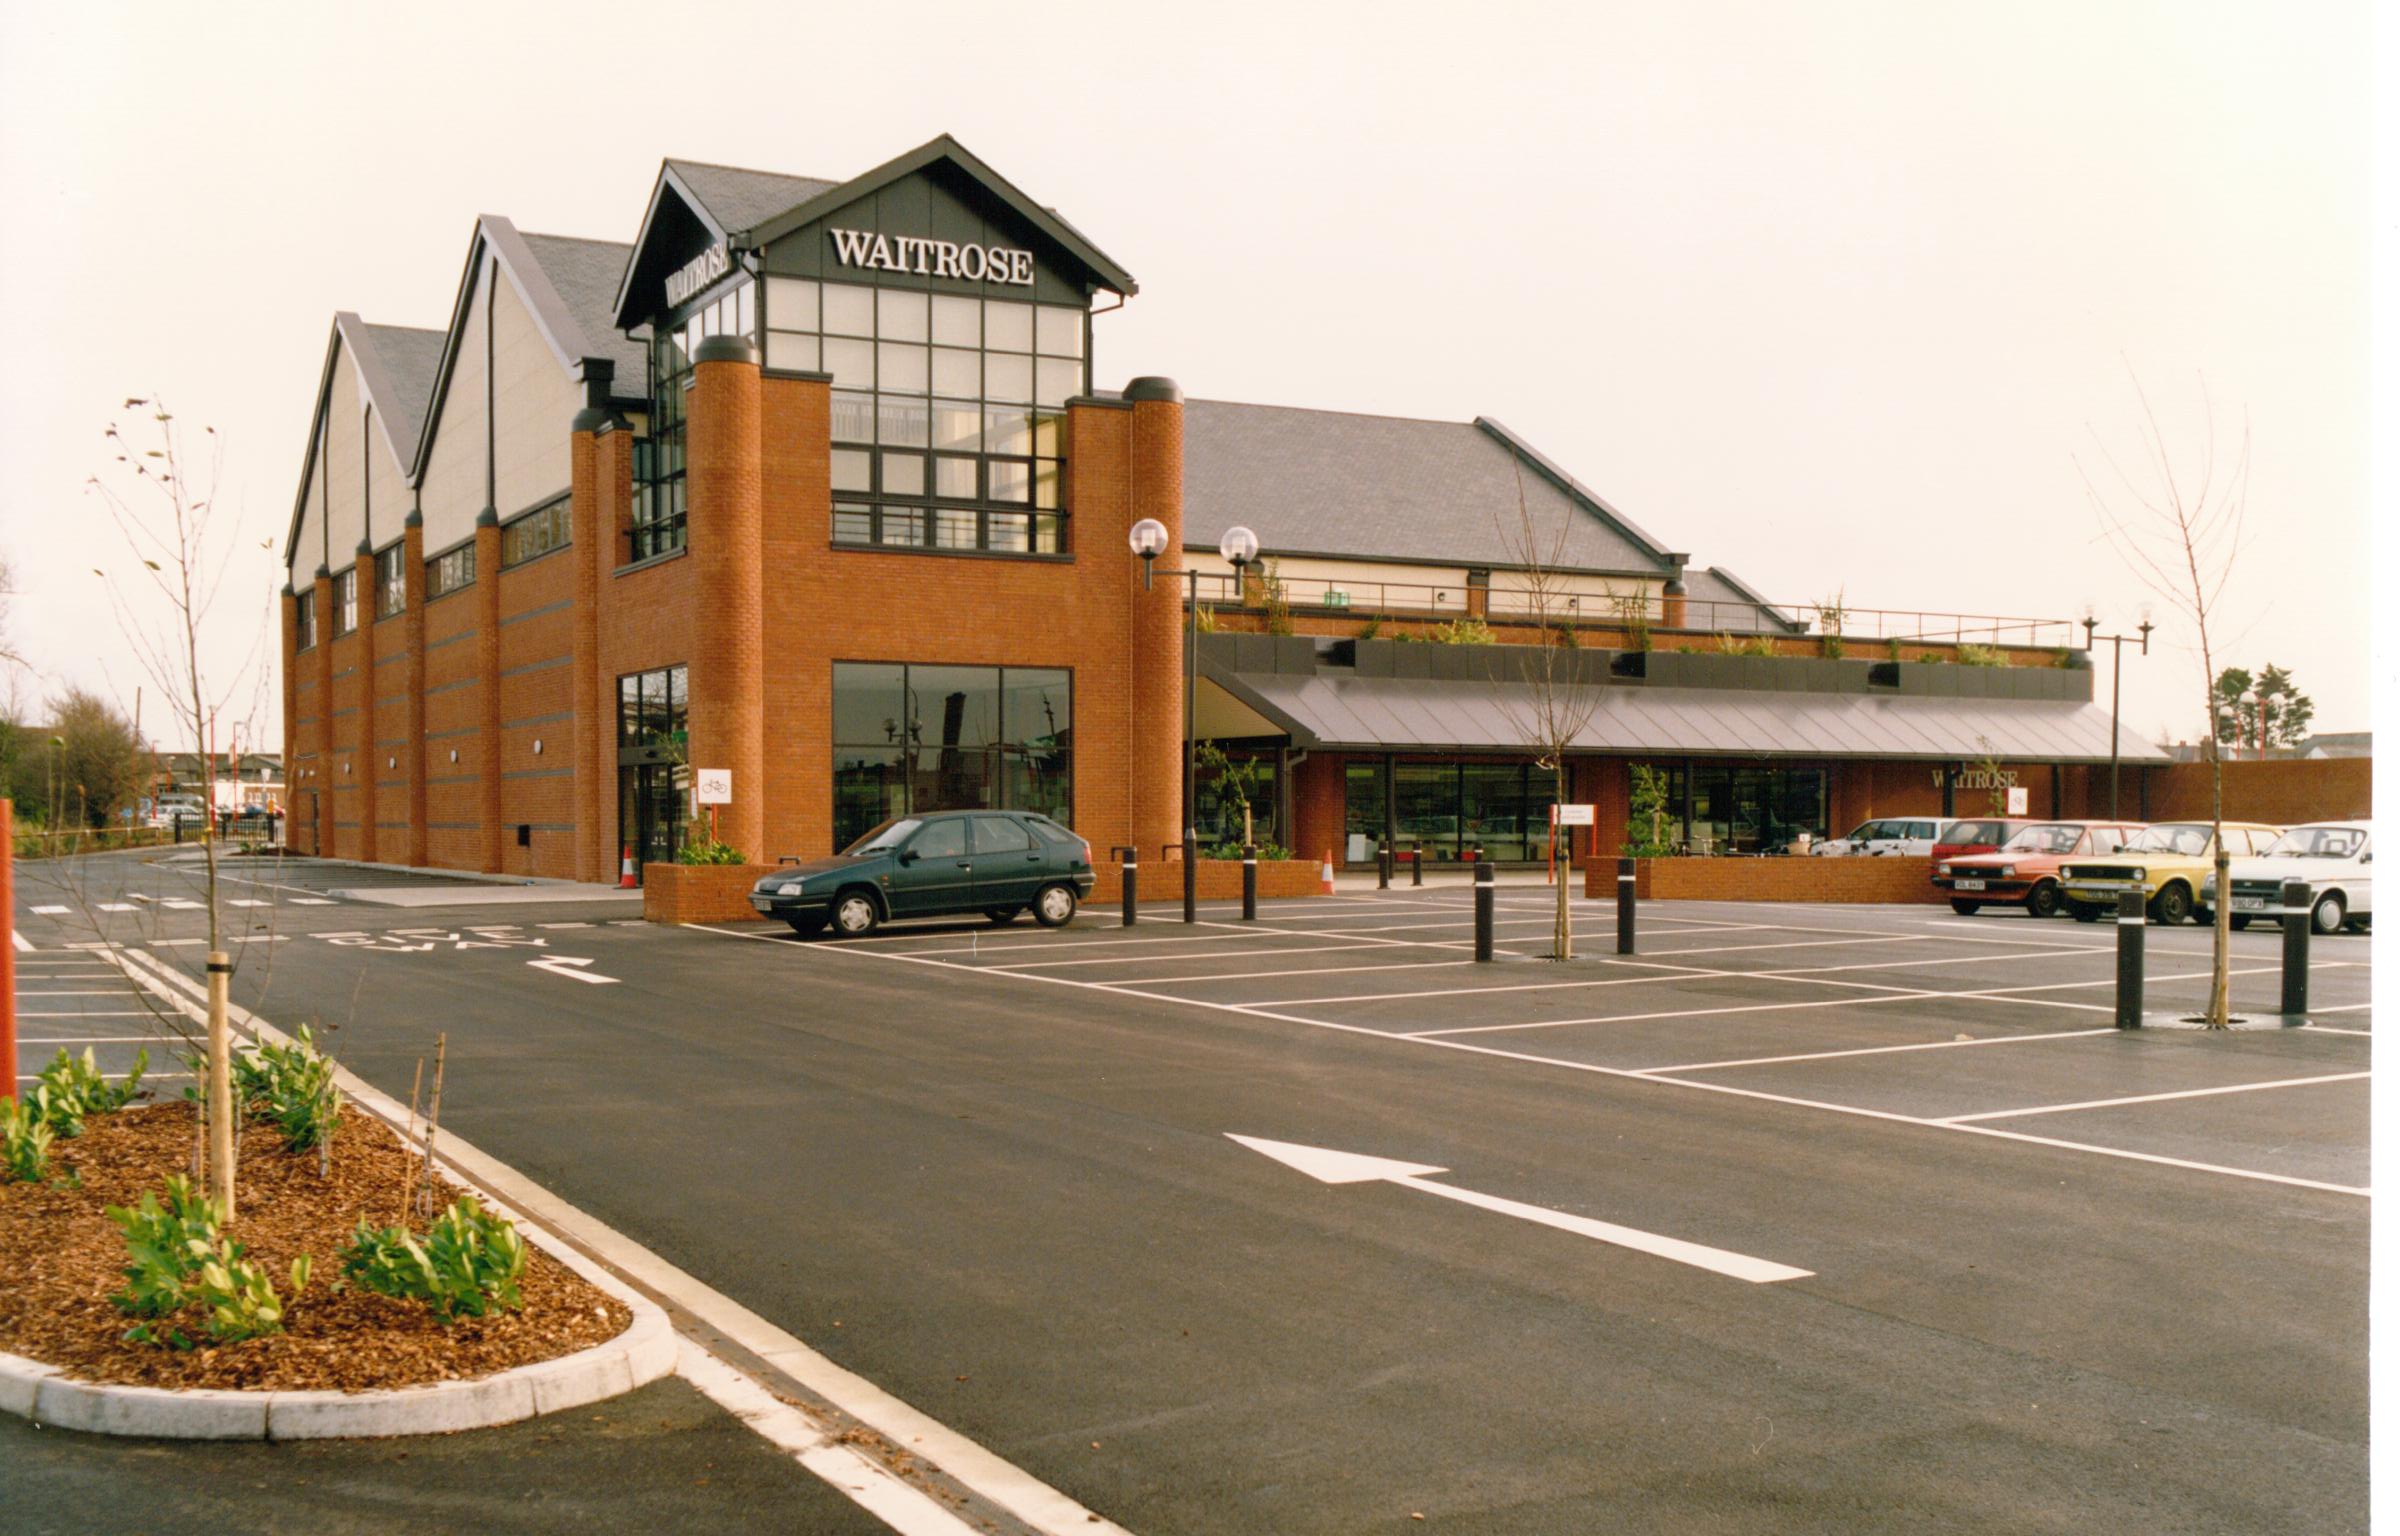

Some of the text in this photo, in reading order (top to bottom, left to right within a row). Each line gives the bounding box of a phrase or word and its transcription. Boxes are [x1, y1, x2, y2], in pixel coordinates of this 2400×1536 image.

[831, 228, 1034, 285] WAITROSE
[665, 243, 729, 309] WAITROSE
[328, 931, 526, 945] GIVE
[361, 938, 550, 952] WAY
